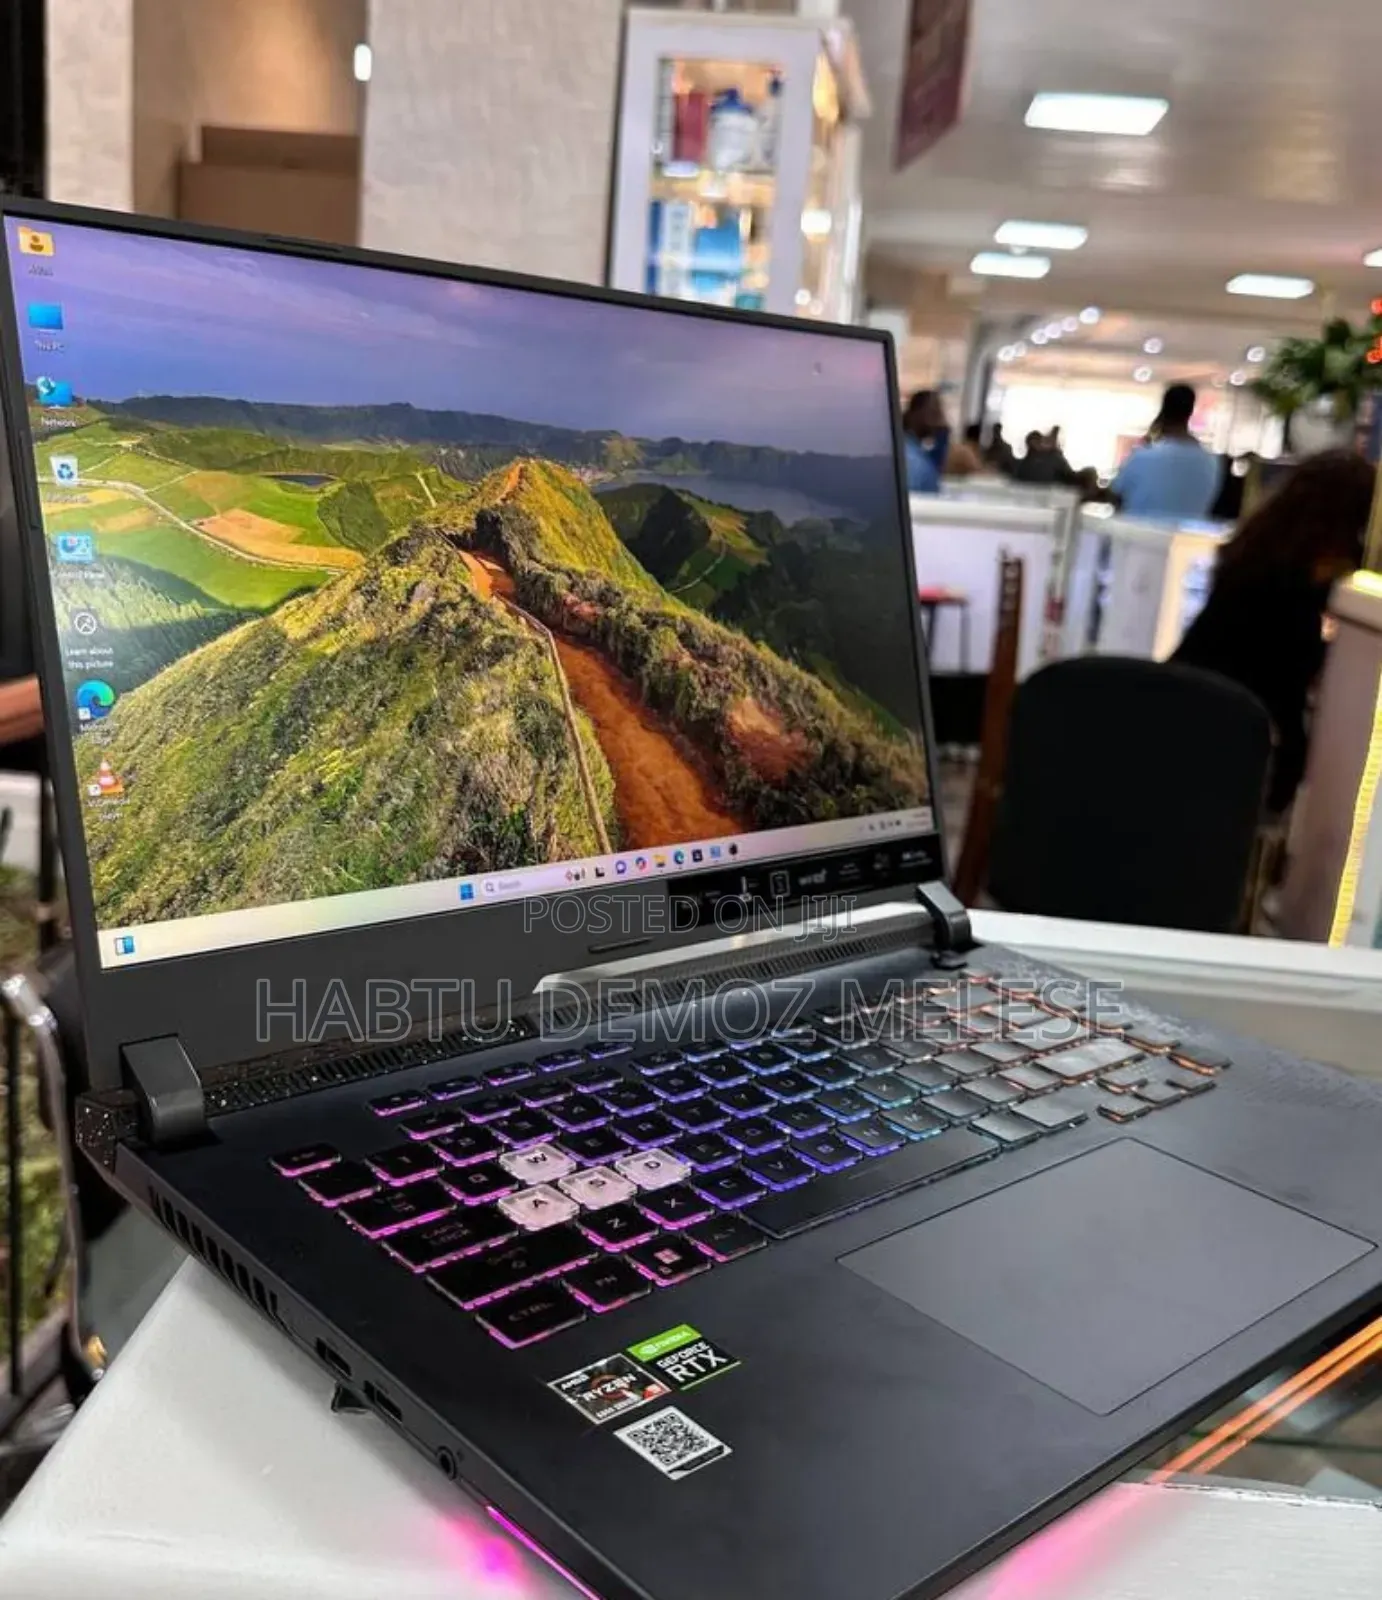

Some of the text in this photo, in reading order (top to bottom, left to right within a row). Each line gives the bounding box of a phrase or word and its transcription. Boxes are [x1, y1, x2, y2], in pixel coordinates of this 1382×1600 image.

[526, 1152, 548, 1165] W
[532, 1198, 548, 1209] A
[655, 1341, 711, 1369] GEFORCE
[664, 1348, 728, 1383] RTX
[582, 1373, 638, 1402] RYZEN
